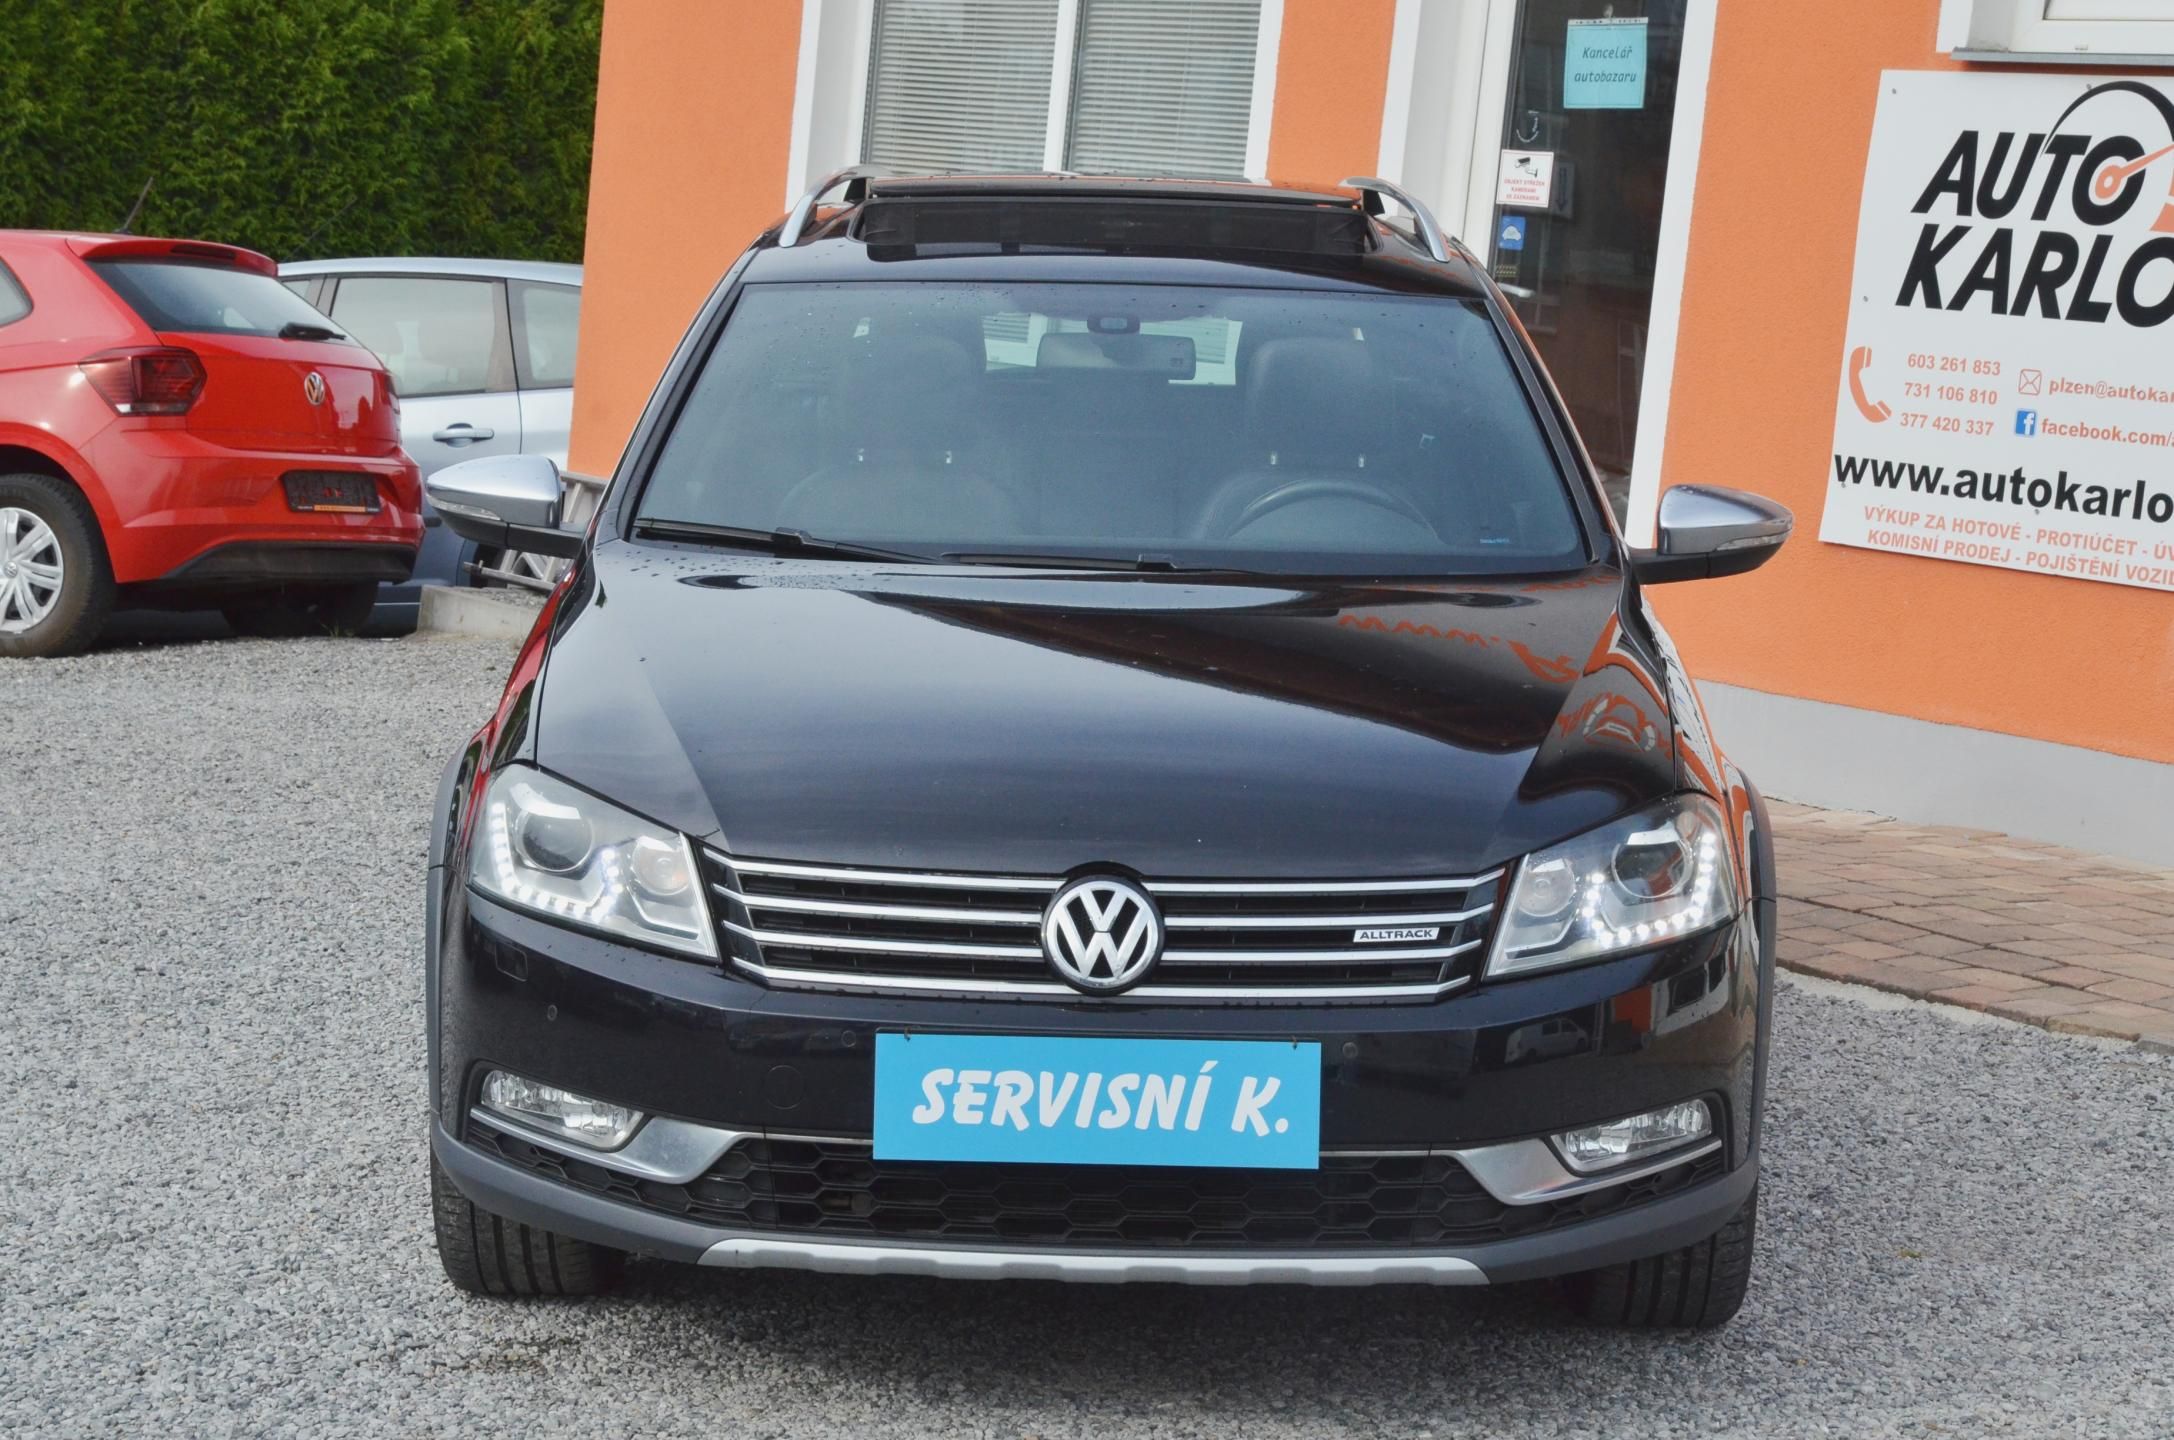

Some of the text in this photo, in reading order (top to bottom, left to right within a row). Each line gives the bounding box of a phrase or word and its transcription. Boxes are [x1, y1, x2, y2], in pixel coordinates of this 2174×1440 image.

[1582, 46, 1633, 59] Kancelář
[1574, 70, 1637, 83] autobazaru
[1910, 130, 2147, 227] AUTO
[1895, 223, 2174, 328] KARLO
[1908, 353, 2001, 376] 603 261 853
[1905, 382, 1998, 405] 731 106 810
[1900, 412, 1994, 436] 377 420 337
[1834, 454, 2174, 524] www.autokarlo
[1864, 504, 1920, 526] VÝKUP
[1924, 514, 1946, 531] ZA
[1952, 517, 2021, 541] HOTOVÉ
[2036, 528, 2138, 556] PROTIÚČET
[1867, 529, 1939, 553] KOMISNÍ
[1943, 539, 2011, 563] PRODEJ
[2026, 551, 2120, 578] POJIŠTĚNÍ
[1359, 929, 1433, 940] ALLTRACK
[912, 1060, 1290, 1138] SERVISNÍ K.
